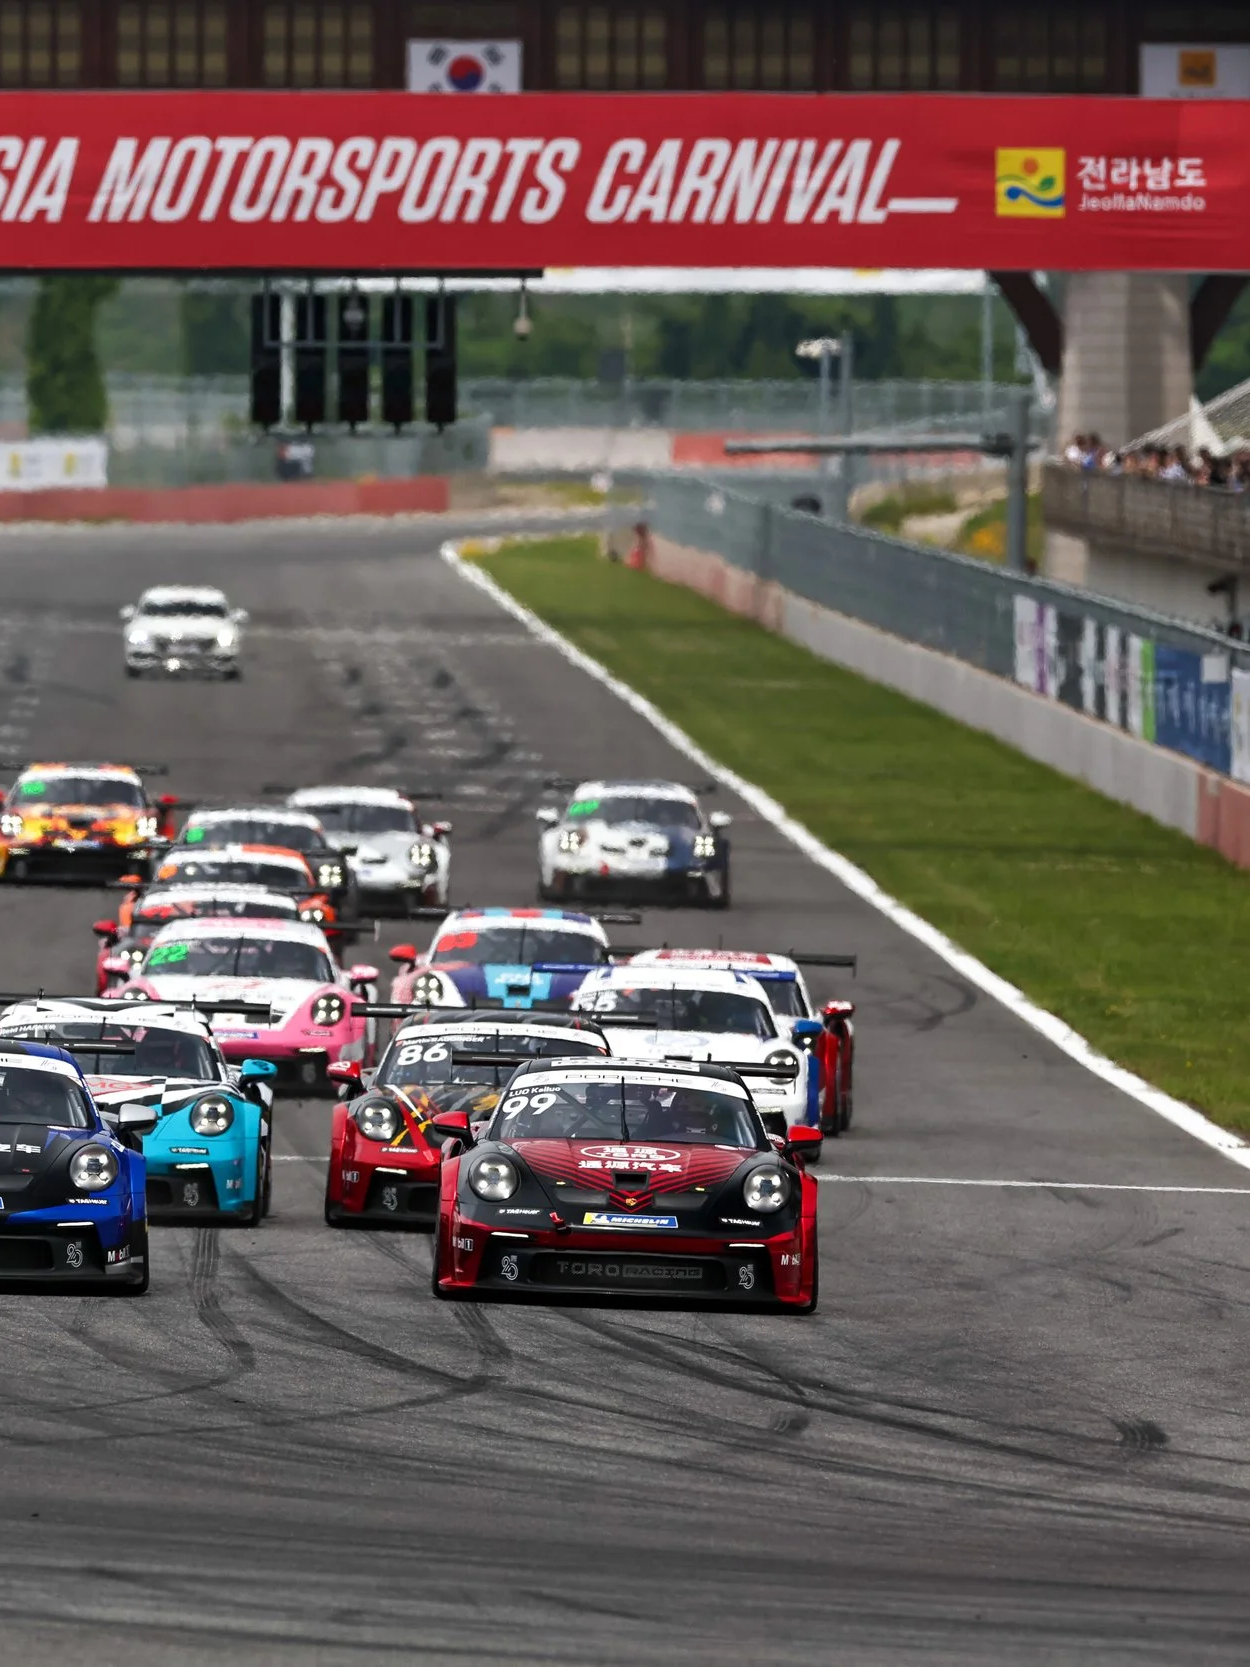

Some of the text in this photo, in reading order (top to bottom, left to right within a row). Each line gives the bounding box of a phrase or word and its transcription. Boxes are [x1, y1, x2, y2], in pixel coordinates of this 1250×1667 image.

[86, 136, 581, 223] MOTORSPORTS
[586, 137, 902, 223] CARNIVAL
[1076, 155, 1208, 191] 전라남도
[397, 1042, 449, 1066] 86
[509, 1088, 530, 1097] LUO
[502, 1093, 557, 1120] 99
[556, 1261, 620, 1277] TORO
